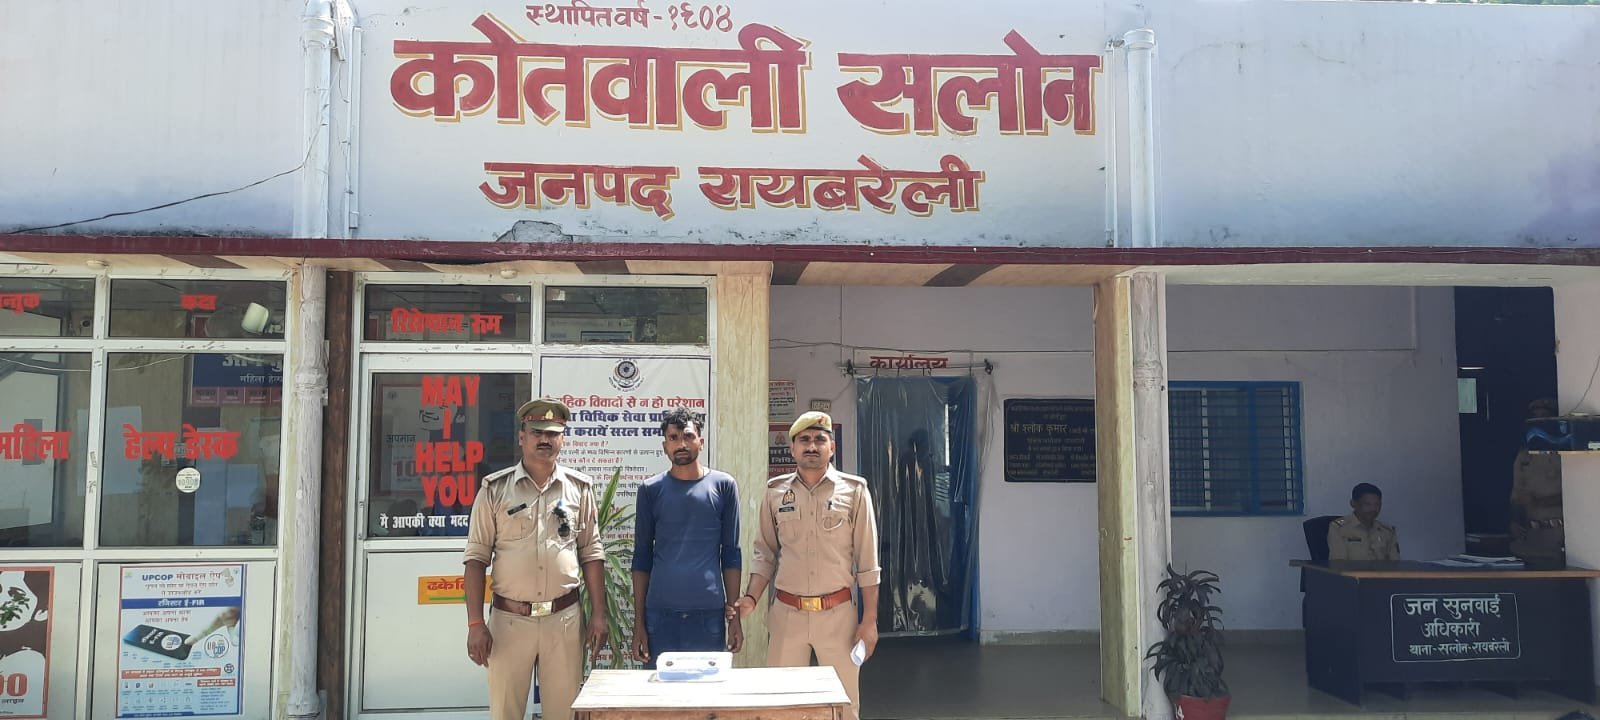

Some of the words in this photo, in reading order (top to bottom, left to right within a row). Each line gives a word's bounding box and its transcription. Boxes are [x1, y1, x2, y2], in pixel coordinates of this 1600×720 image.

[526, 0, 613, 27] स्थापित
[614, 0, 650, 28] वर्ष
[390, 13, 811, 134] कोतवाली
[837, 29, 1102, 136] सलोन
[480, 161, 681, 219] जनपद
[698, 154, 986, 216] रायबरेली
[870, 354, 949, 369] कार्यालय
[420, 375, 481, 407] MAY
[590, 395, 624, 408] विवादों
[626, 396, 636, 408] से
[640, 399, 649, 408] न
[652, 395, 664, 408] हो
[667, 396, 705, 408] परेशान
[442, 408, 454, 439] I
[580, 410, 619, 422] विधिक
[622, 410, 647, 422] सेवा
[122, 423, 179, 460] हेल्प
[611, 427, 639, 437] सरल
[415, 440, 485, 473] HELP
[421, 474, 477, 508] YOU
[392, 512, 425, 529] आपकी
[427, 515, 446, 527] क्या
[450, 515, 469, 527] मदद
[1404, 598, 1438, 615] जन
[1442, 594, 1501, 619] सुनवाई
[1421, 618, 1481, 637] अधिकारी
